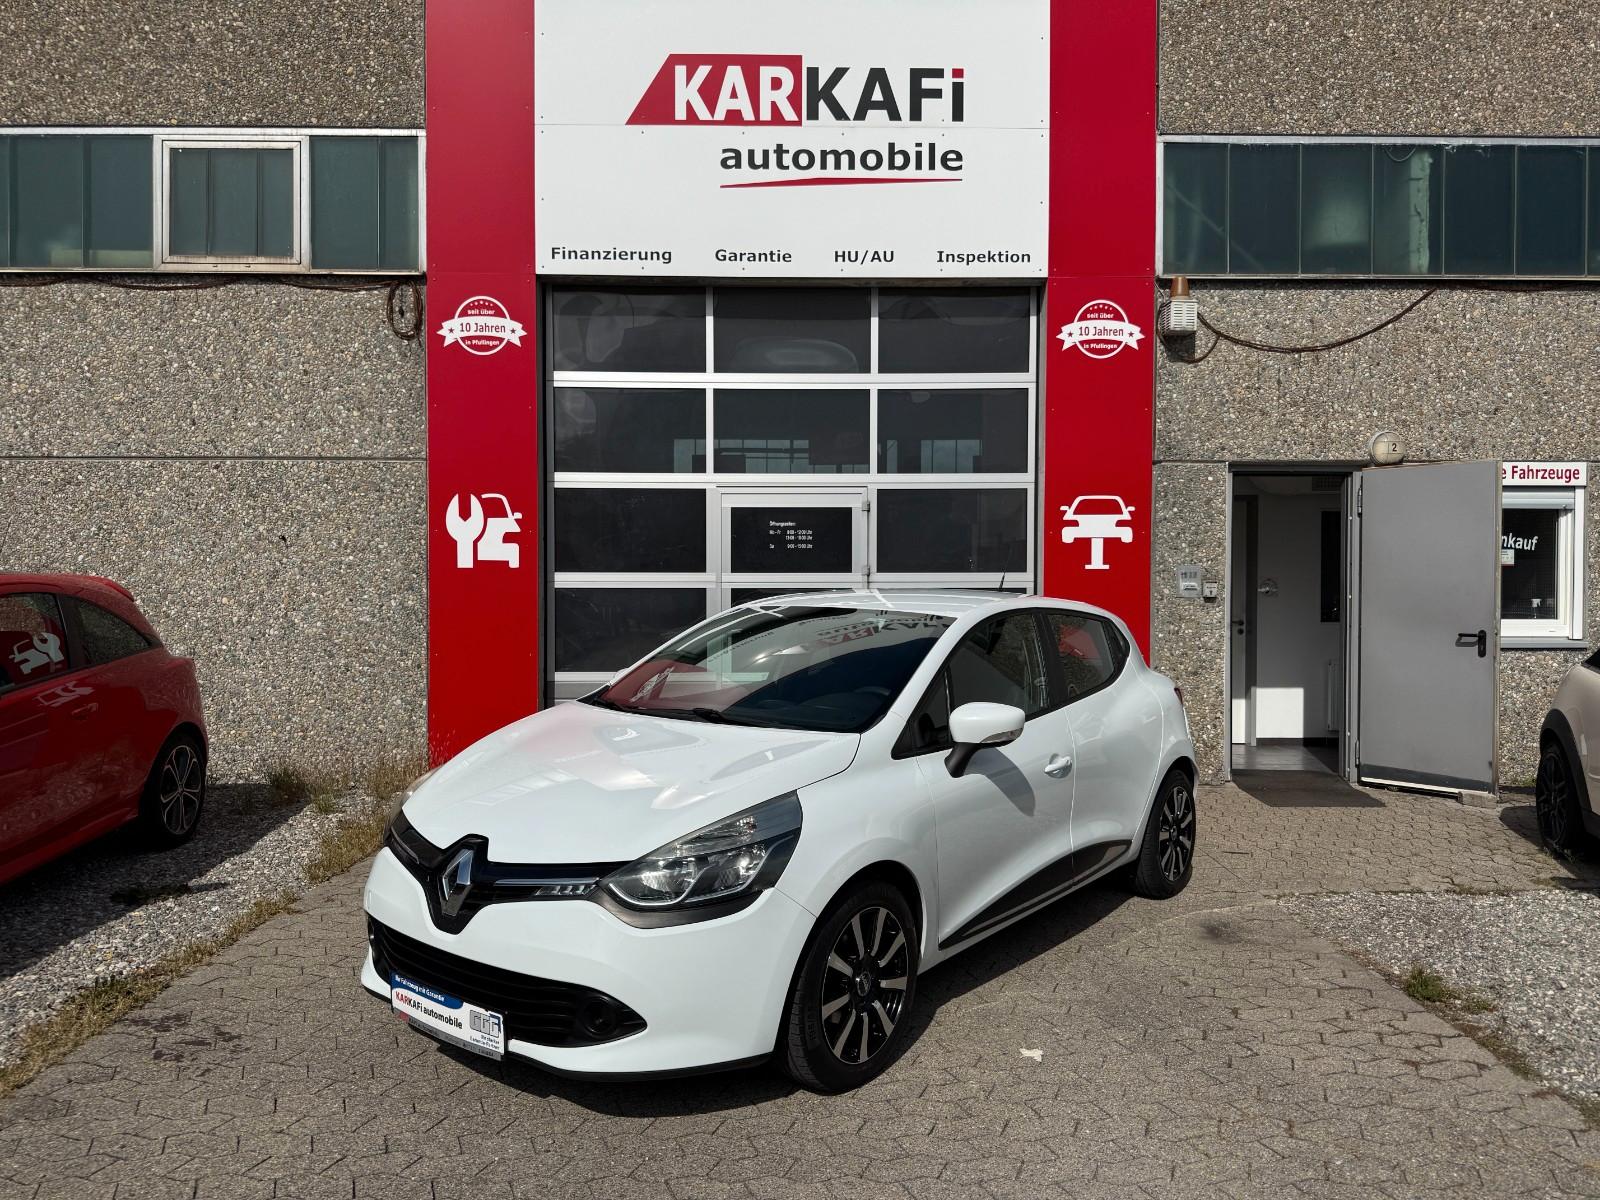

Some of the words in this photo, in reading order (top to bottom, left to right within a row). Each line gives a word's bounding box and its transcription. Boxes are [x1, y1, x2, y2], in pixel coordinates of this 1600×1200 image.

[720, 142, 963, 171] automobile
[551, 247, 672, 264] Finanzierung
[715, 248, 792, 263] Garantie
[834, 250, 894, 264] HU/AU
[937, 250, 1031, 265] Inspektion
[460, 323, 471, 333] 10
[474, 323, 506, 333] Jahren
[1079, 326, 1090, 336] 10
[1092, 326, 1124, 336] Jahren
[1391, 442, 1398, 452] 2
[1511, 465, 1580, 483] Fahrzeuge
[401, 977, 419, 992] Fahrzeug
[423, 1006, 463, 1030] automobile
